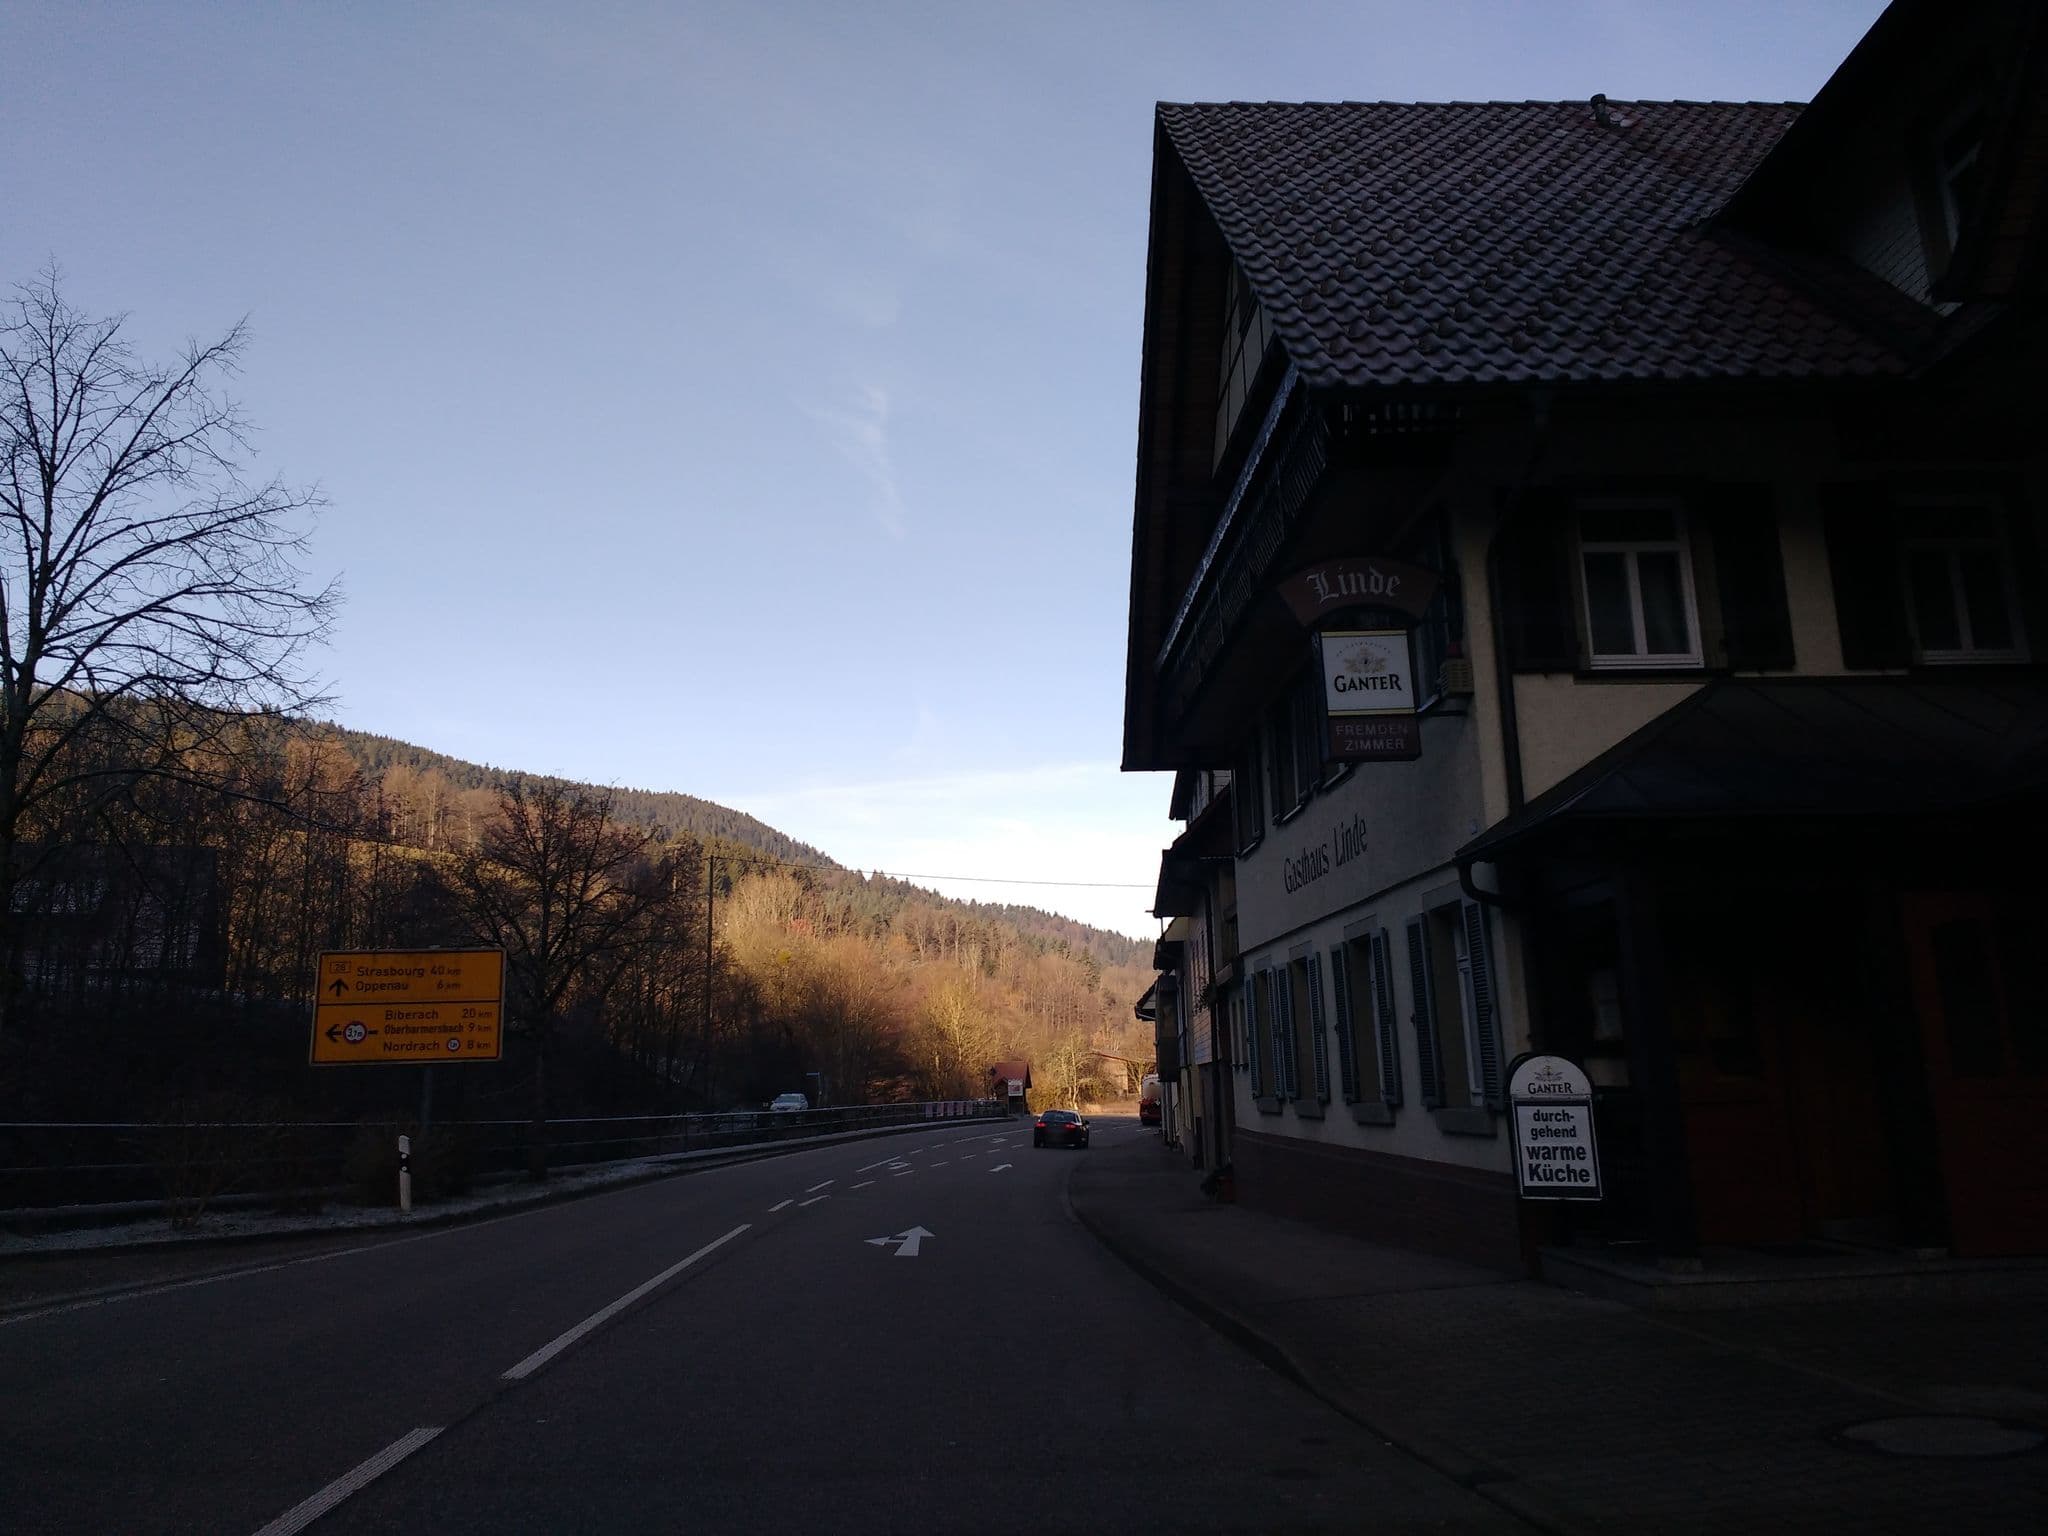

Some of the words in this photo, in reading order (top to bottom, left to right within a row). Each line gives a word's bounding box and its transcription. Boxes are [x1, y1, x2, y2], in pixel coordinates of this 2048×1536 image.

[1305, 566, 1400, 604] Linde
[1334, 674, 1402, 693] GANTER
[1336, 723, 1408, 737] FREMDEN
[1344, 738, 1405, 752] ZIMMER
[1284, 843, 1330, 894] Gasthaus
[1333, 813, 1368, 867] Linde
[356, 965, 425, 978] Strasbourg
[447, 967, 462, 976] km
[355, 980, 409, 993] Oppenau
[384, 1008, 439, 1021] Biberach
[462, 1008, 476, 1018] 20
[478, 1009, 493, 1018] km
[468, 1022, 475, 1032] 9
[478, 1023, 492, 1033] km
[383, 1040, 440, 1052] Nordrach
[476, 1041, 491, 1049] km
[1527, 1082, 1573, 1094] GANTER
[1533, 1109, 1574, 1122] durch-
[1531, 1126, 1577, 1140] gehend
[1526, 1145, 1587, 1160] warme
[1528, 1163, 1590, 1182] Küche
